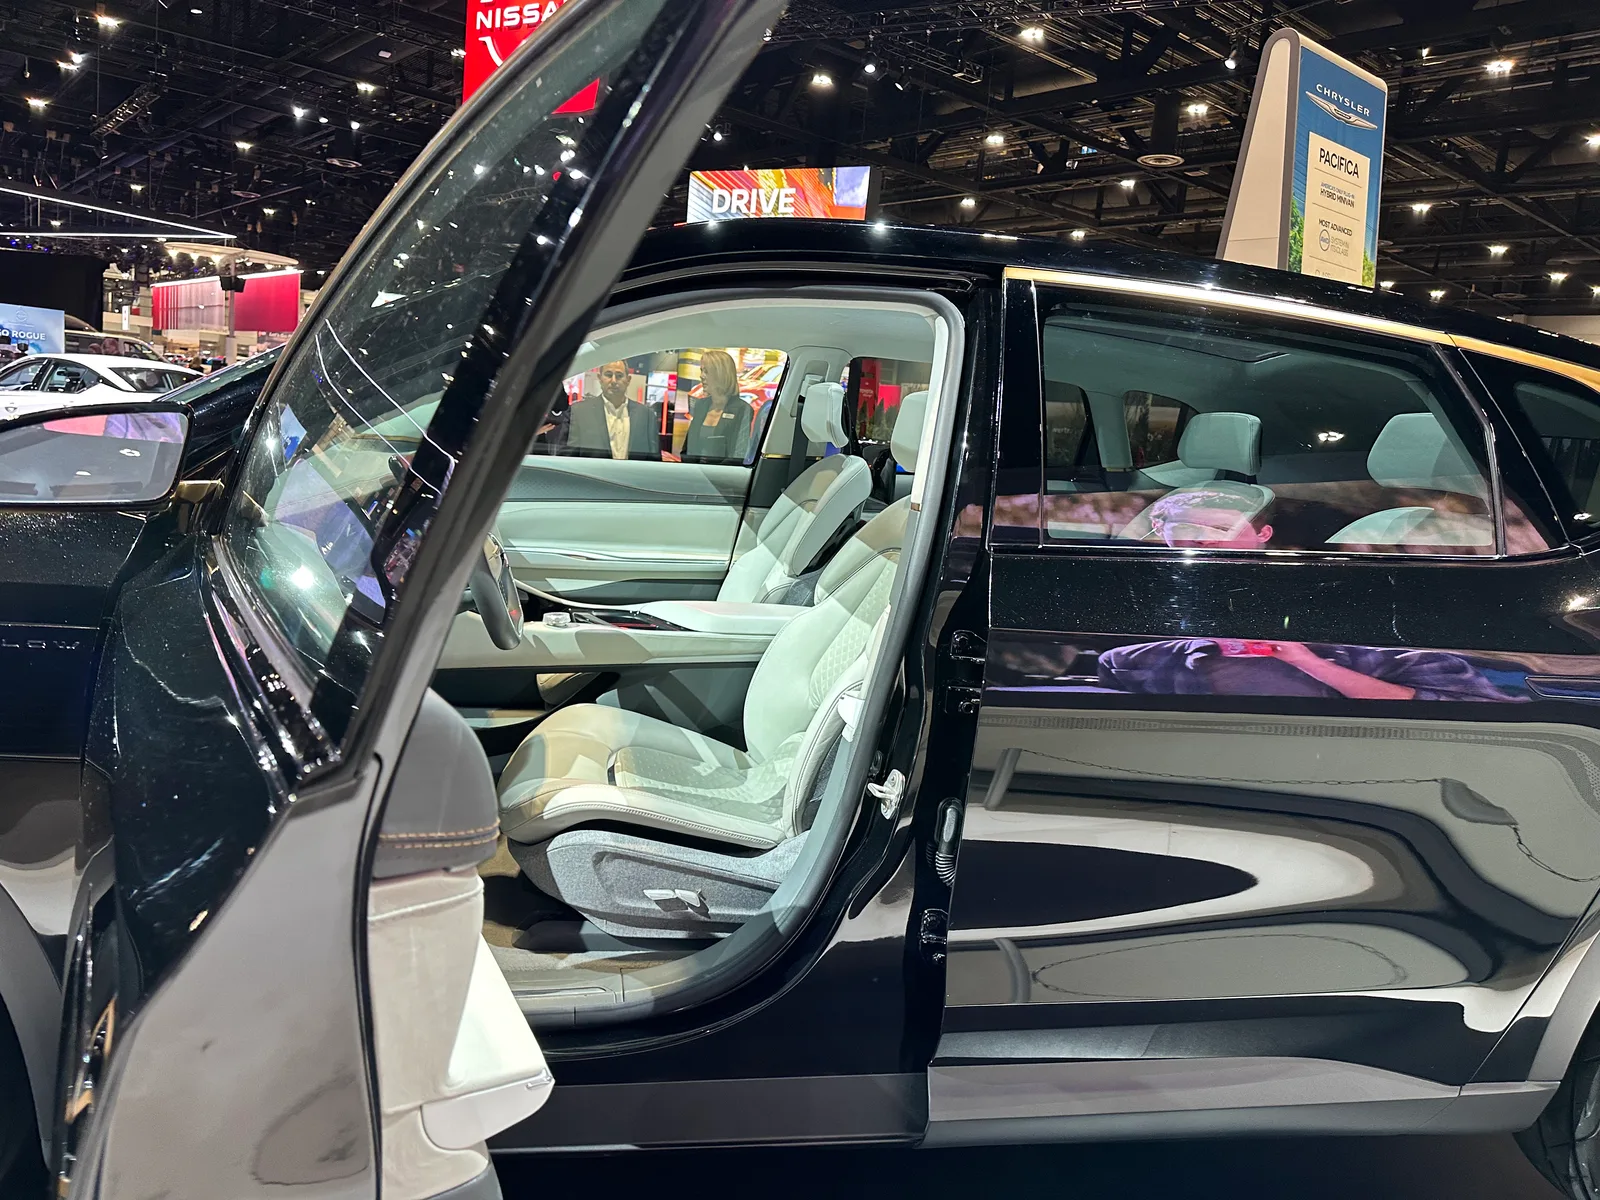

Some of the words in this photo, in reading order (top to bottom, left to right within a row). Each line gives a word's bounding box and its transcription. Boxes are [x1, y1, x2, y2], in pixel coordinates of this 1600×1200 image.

[475, 0, 567, 30] NISSA
[1316, 84, 1370, 117] CHRYSLER
[1319, 147, 1360, 178] PACIFICA
[712, 188, 796, 213] DRIVE
[1319, 218, 1330, 228] MOST
[1330, 223, 1353, 237] ADVANCED
[12, 330, 46, 340] ROGUE
